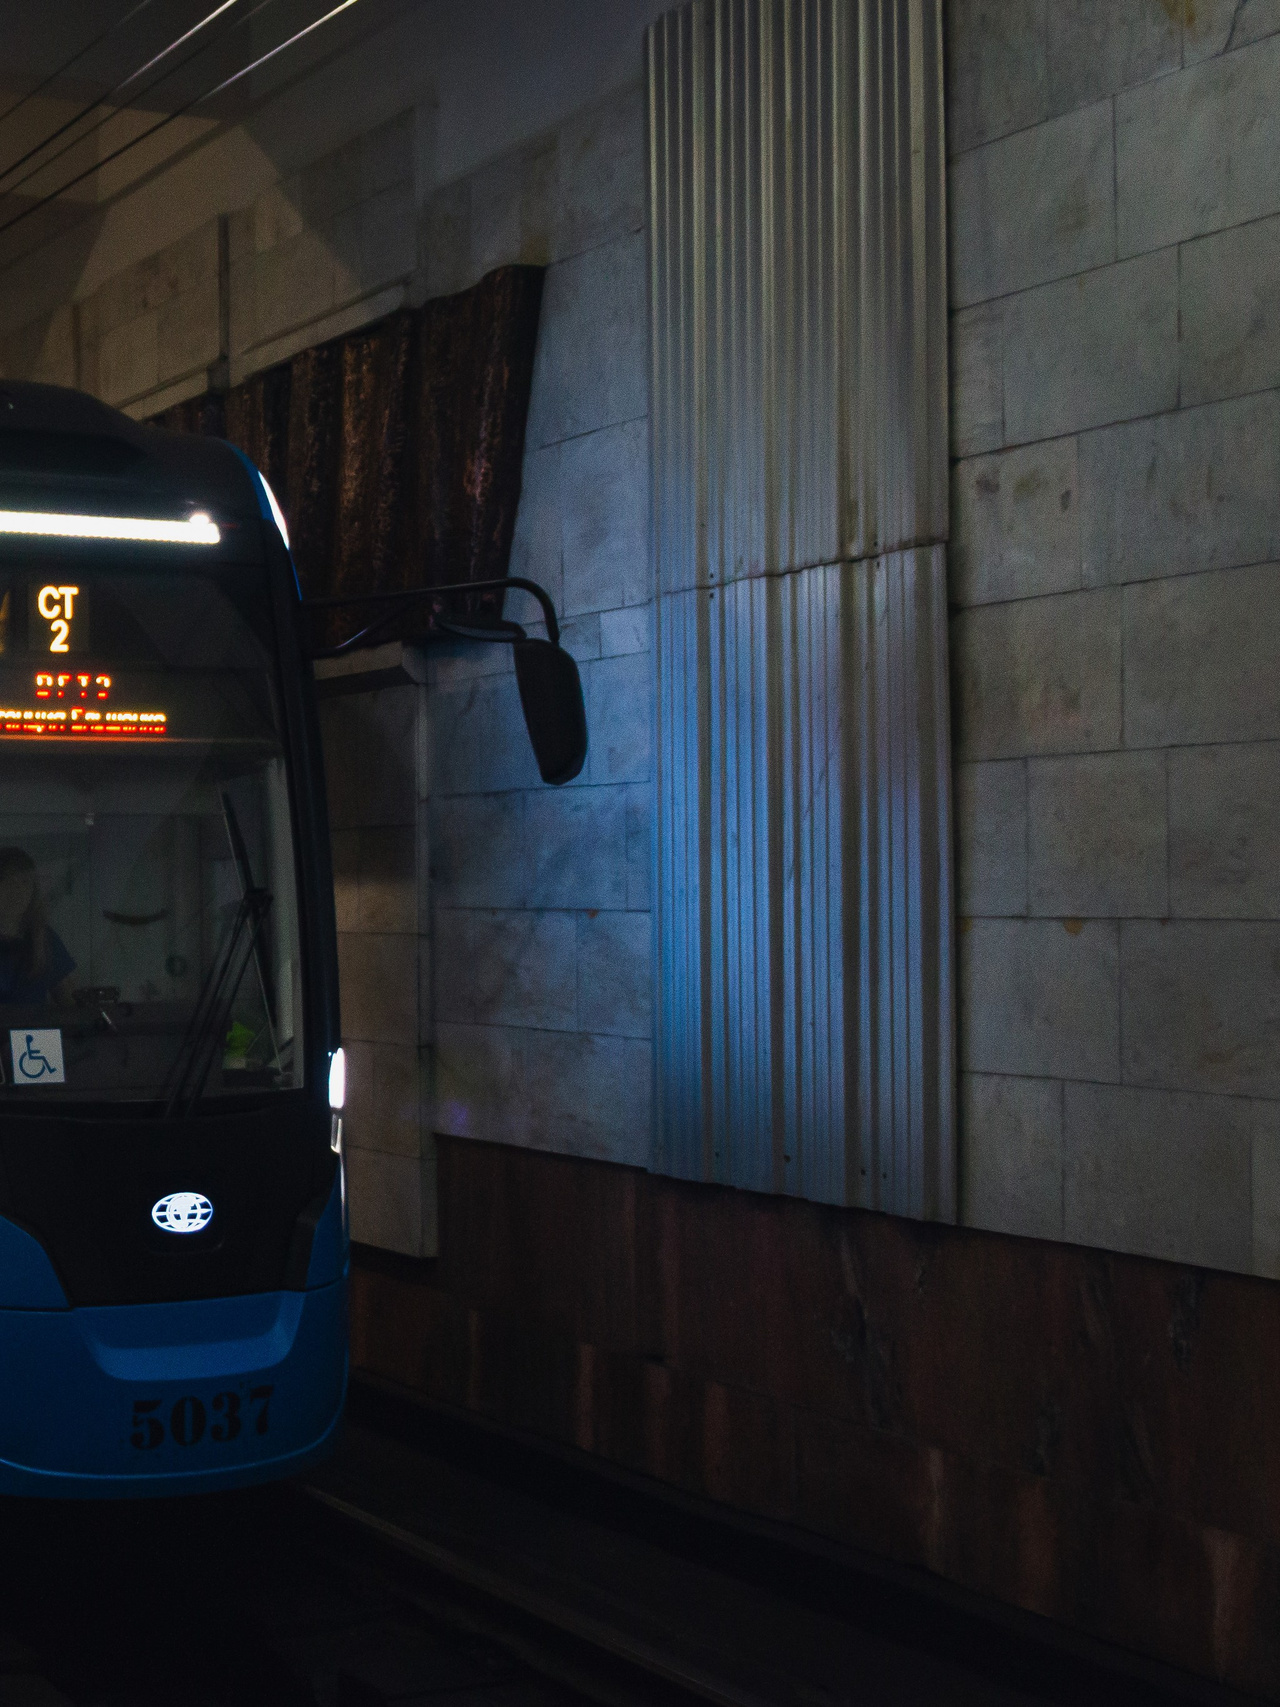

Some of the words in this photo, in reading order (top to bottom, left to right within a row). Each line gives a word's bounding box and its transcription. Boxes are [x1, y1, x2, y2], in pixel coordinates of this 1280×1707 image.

[37, 585, 80, 620] СТ
[49, 619, 70, 653] 2
[130, 1385, 274, 1450] 5037
